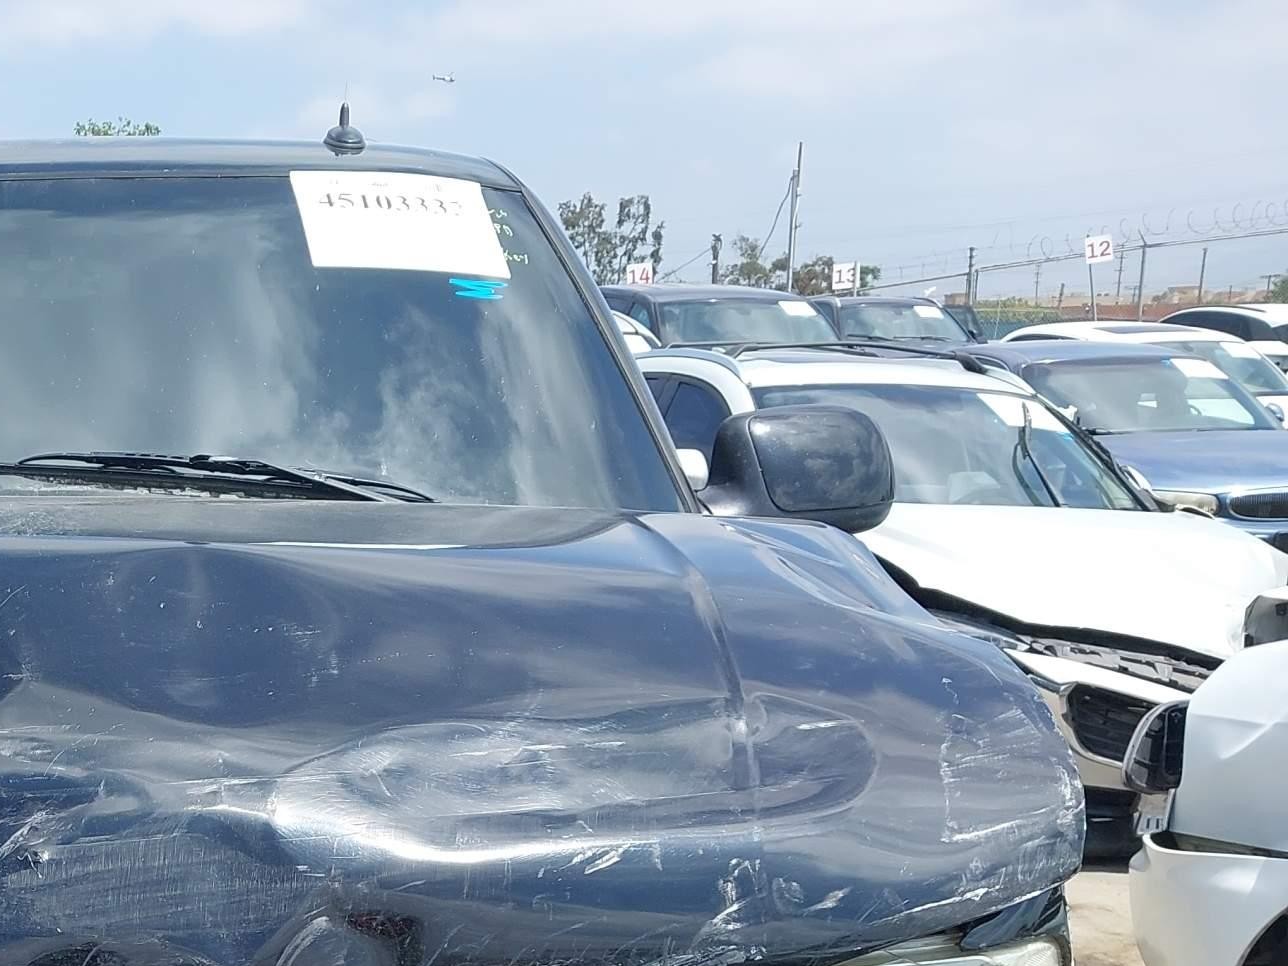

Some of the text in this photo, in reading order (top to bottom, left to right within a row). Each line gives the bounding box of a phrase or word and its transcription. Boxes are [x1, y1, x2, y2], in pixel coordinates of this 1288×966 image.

[1087, 240, 1111, 259] 12
[628, 263, 650, 284] 14
[835, 267, 855, 284] 13
